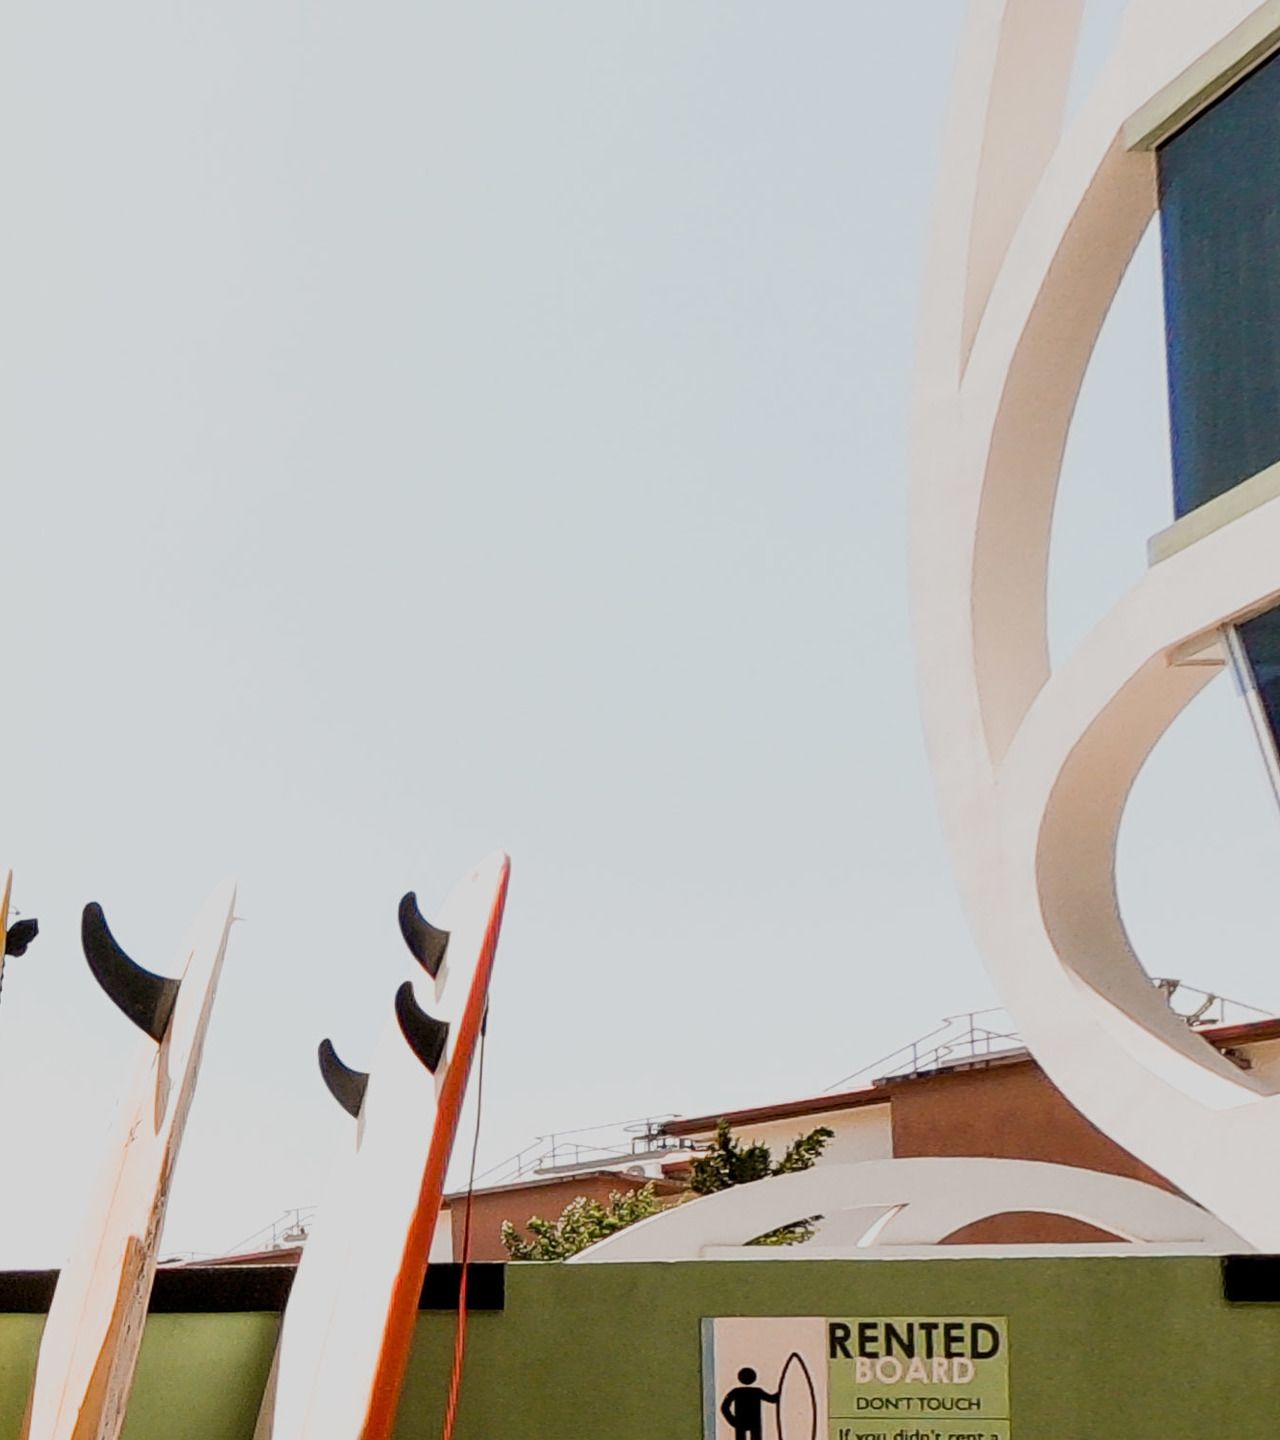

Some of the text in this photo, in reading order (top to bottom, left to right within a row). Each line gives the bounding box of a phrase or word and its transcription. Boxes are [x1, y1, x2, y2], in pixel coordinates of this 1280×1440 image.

[828, 1321, 1000, 1360] RENTED
[854, 1355, 976, 1385] BOARD
[915, 1397, 981, 1411] TOUCH
